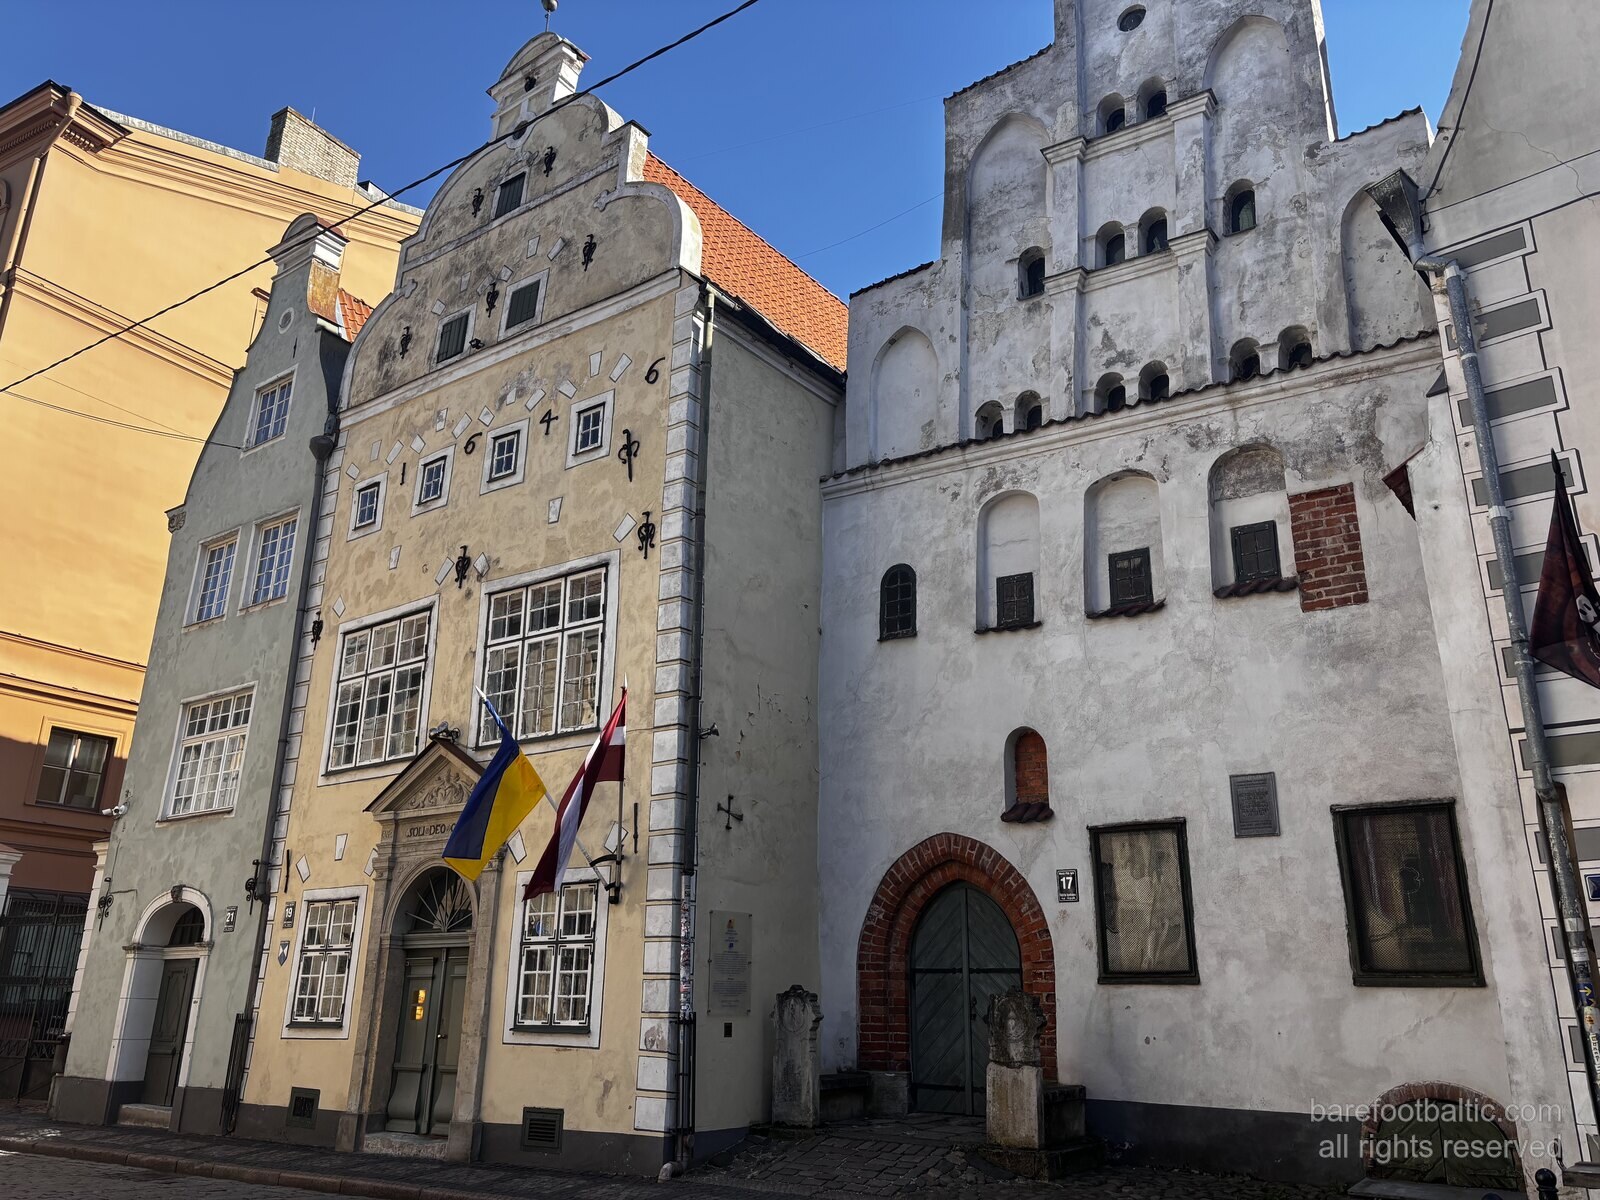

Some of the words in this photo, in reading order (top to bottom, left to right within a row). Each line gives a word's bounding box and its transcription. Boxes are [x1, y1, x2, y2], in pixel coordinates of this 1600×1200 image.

[464, 432, 482, 454] 6
[540, 409, 558, 435] 4
[645, 356, 665, 384] 6
[406, 826, 426, 838] SOLI
[430, 823, 446, 836] DEO
[1060, 876, 1073, 890] 17
[226, 911, 235, 922] 21
[285, 907, 293, 918] 19
